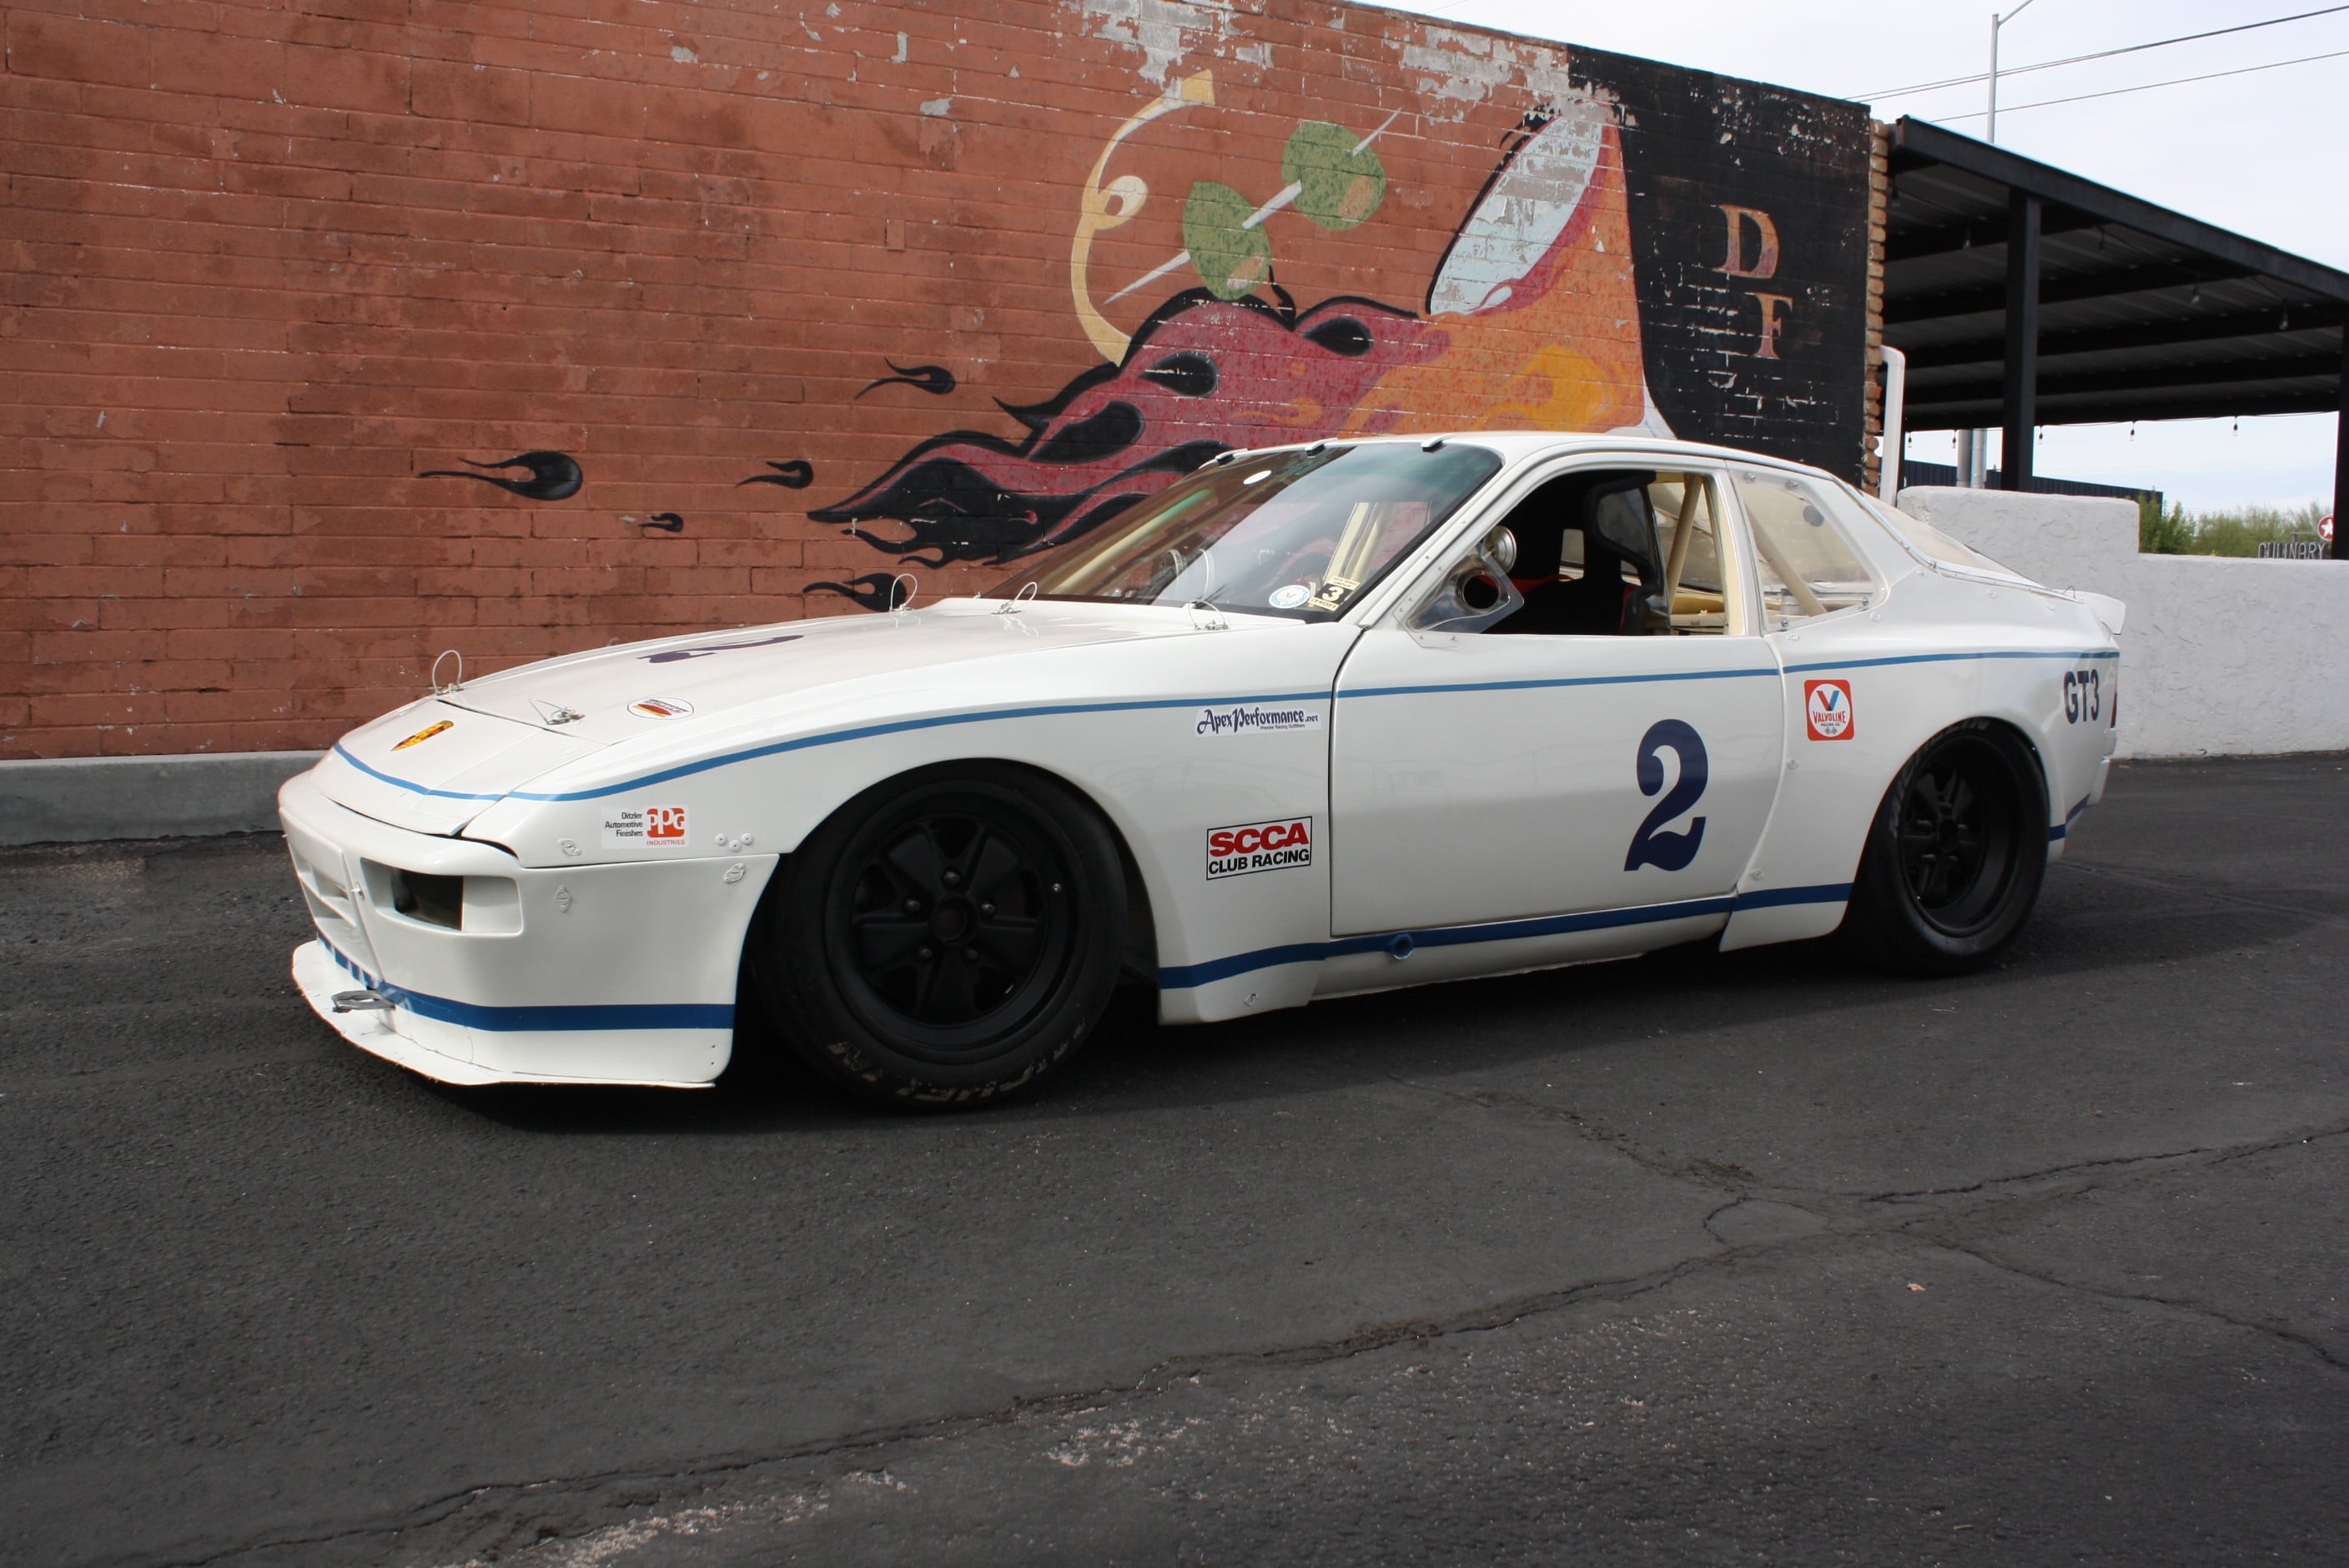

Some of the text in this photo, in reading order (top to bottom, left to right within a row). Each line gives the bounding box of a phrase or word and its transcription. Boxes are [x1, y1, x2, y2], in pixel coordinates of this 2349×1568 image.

[1712, 204, 1780, 279] D
[1750, 291, 1793, 359] F
[2257, 542, 2327, 560] CULINARY
[1321, 585, 1344, 602] 3
[2063, 668, 2100, 725] GT3
[1812, 710, 1847, 724] VALVOLINE
[1623, 718, 1708, 872] 2
[646, 808, 686, 835] PPG
[1210, 822, 1309, 857] SCCA
[1208, 848, 1310, 874] CLUB RACING
